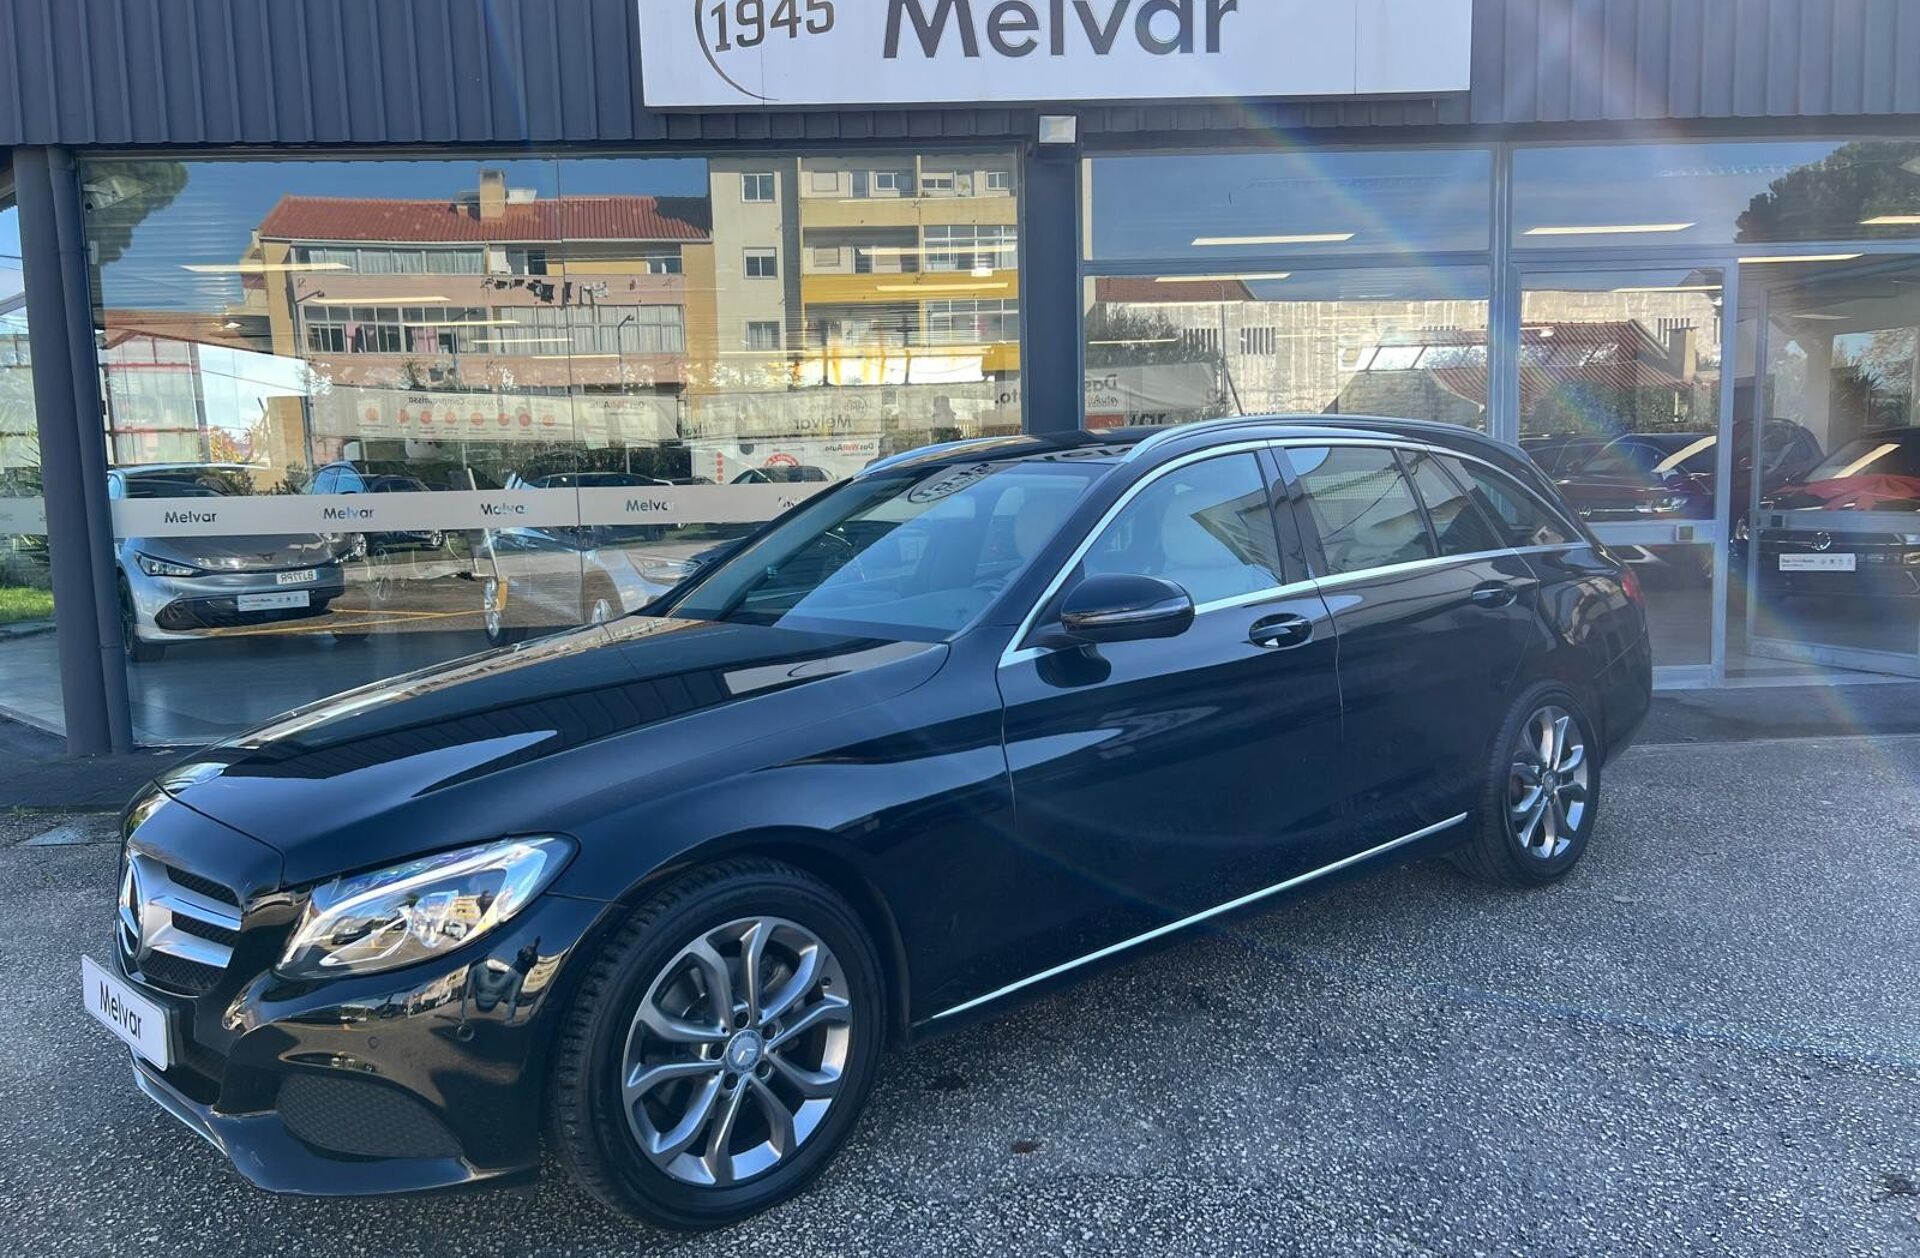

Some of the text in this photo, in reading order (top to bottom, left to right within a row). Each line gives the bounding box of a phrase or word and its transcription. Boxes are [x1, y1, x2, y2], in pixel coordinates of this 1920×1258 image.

[710, 0, 835, 52] 1945
[883, 0, 1237, 58] Melvar
[164, 510, 217, 524] Melvar
[323, 507, 375, 520] Melvar
[100, 980, 141, 1040] Melvar
